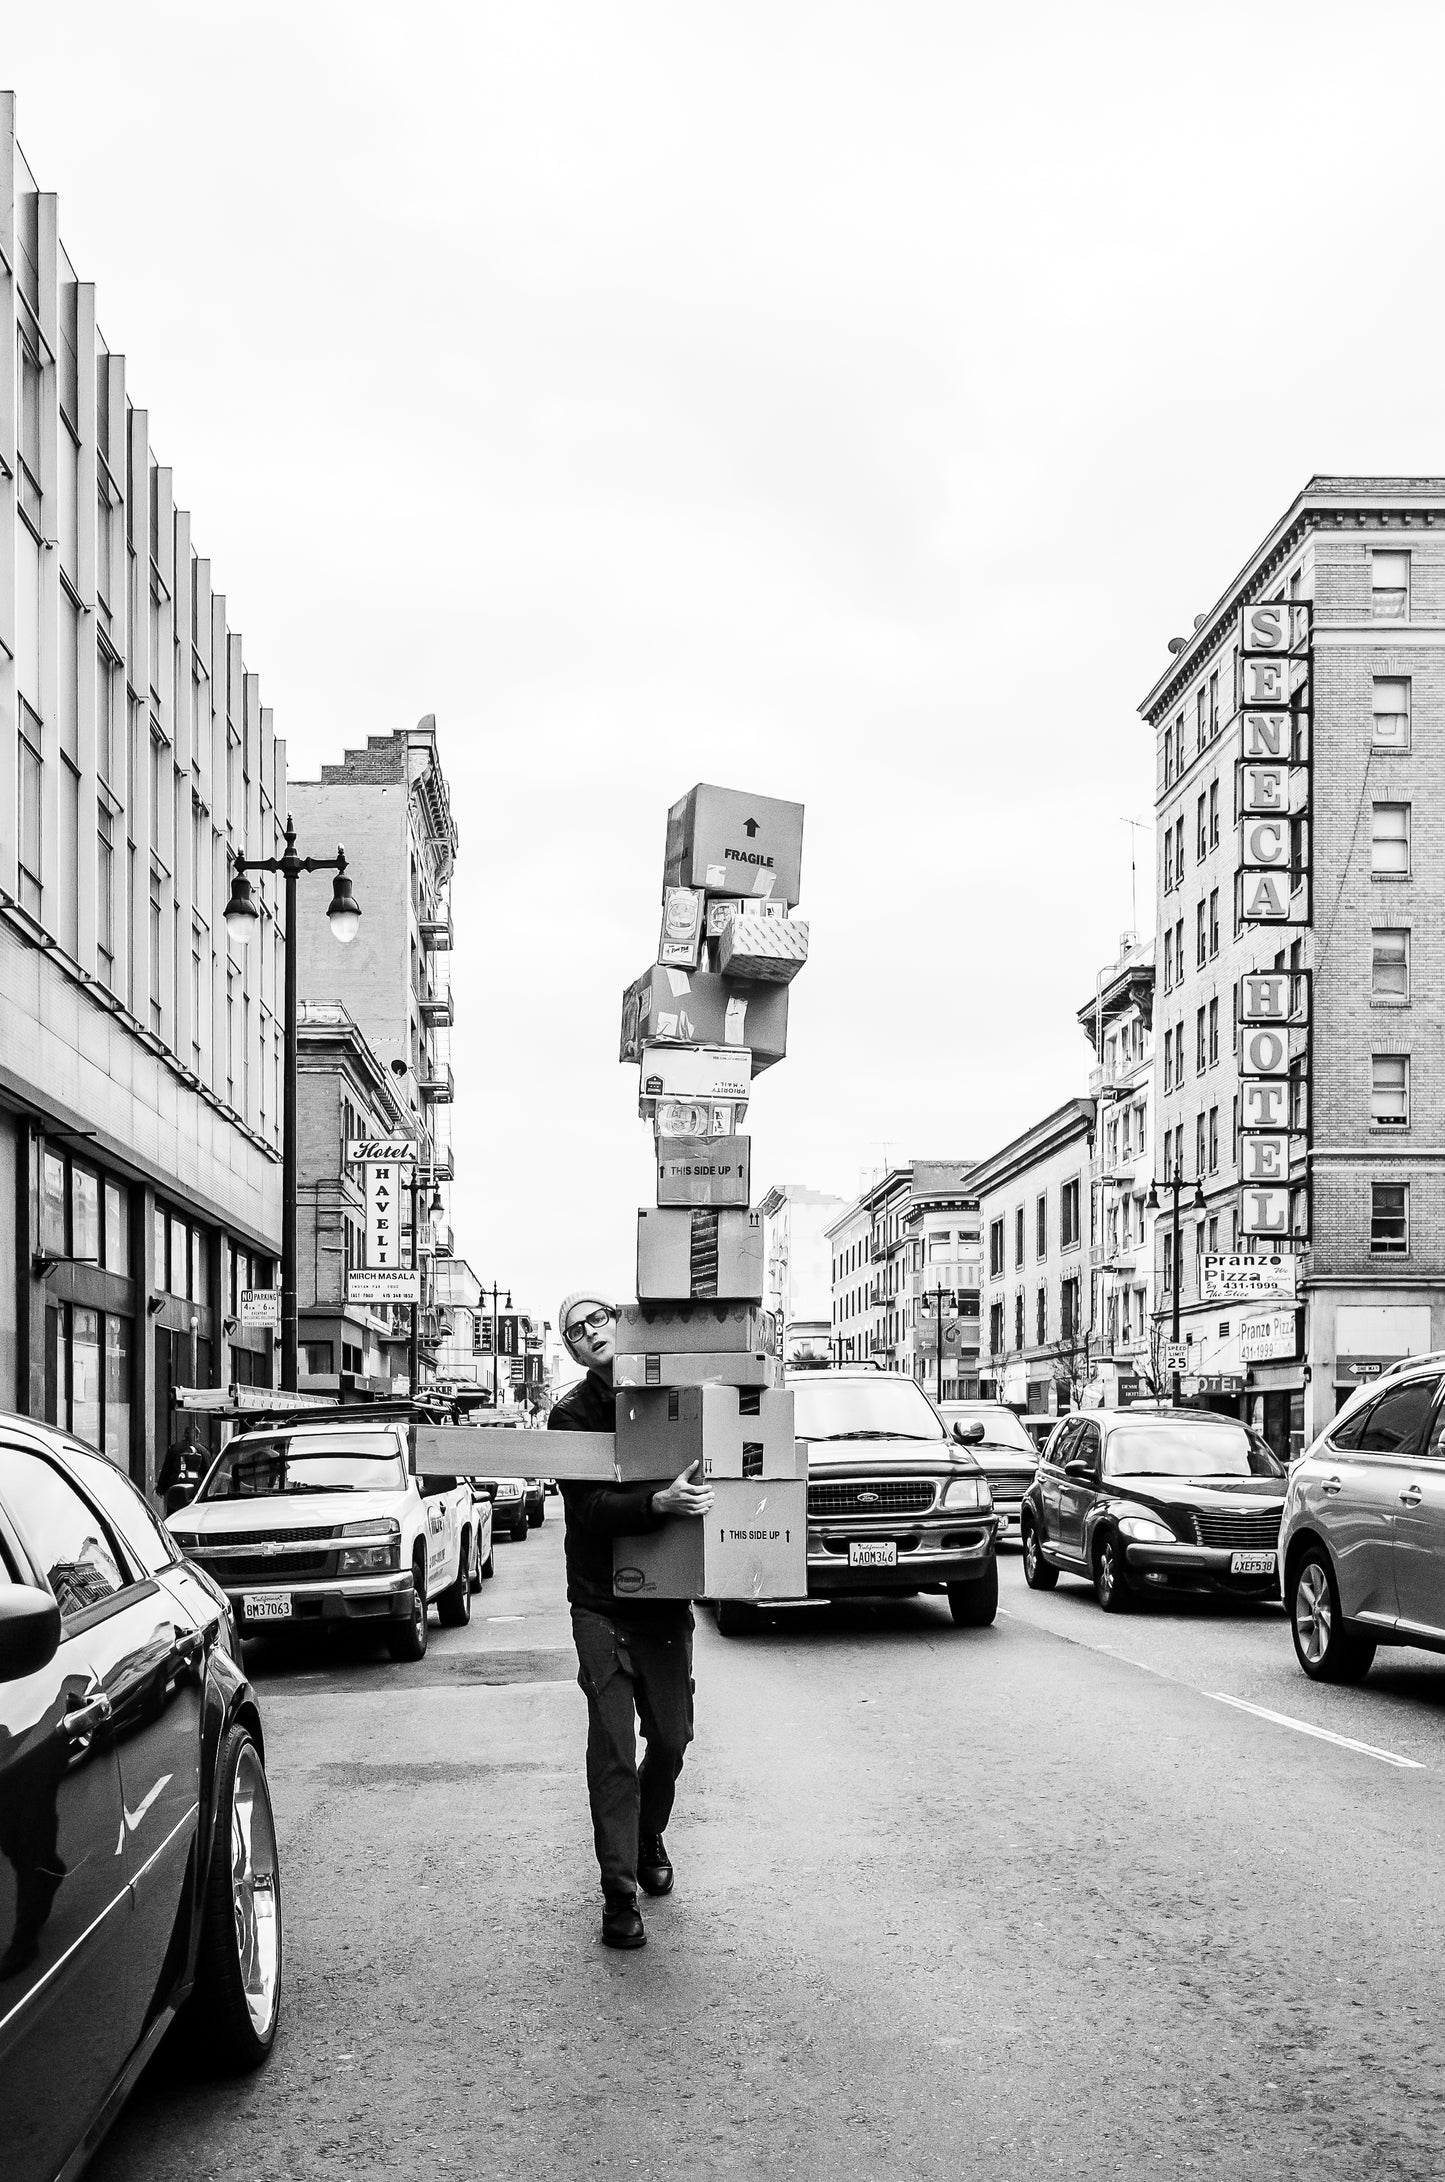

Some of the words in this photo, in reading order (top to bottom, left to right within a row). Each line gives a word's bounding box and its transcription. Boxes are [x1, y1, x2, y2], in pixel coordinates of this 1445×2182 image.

[1246, 608, 1286, 915] SENECA
[724, 848, 774, 868] FRAGILE
[1246, 979, 1285, 1231] HOTEL
[353, 1142, 410, 1159] Hotel
[671, 1166, 692, 1175] THIS
[694, 1166, 716, 1175] SIDE
[718, 1165, 731, 1175] UP
[375, 1168, 390, 1263] HAVELI
[1205, 1256, 1281, 1268] Pranzo
[1204, 1269, 1261, 1281] Pizza
[242, 1291, 252, 1301] NO
[254, 1293, 277, 1301] PARKING
[1242, 1323, 1270, 1341] Pranzo
[1274, 1317, 1295, 1336] Pizza
[1167, 1358, 1187, 1369] 25
[1198, 1377, 1241, 1391] OTEL
[729, 1530, 747, 1539] THIS
[749, 1530, 767, 1539] SIDE
[769, 1530, 780, 1539] UP
[1234, 1561, 1273, 1571] 4XEF538
[246, 1602, 290, 1617] 8M37063
